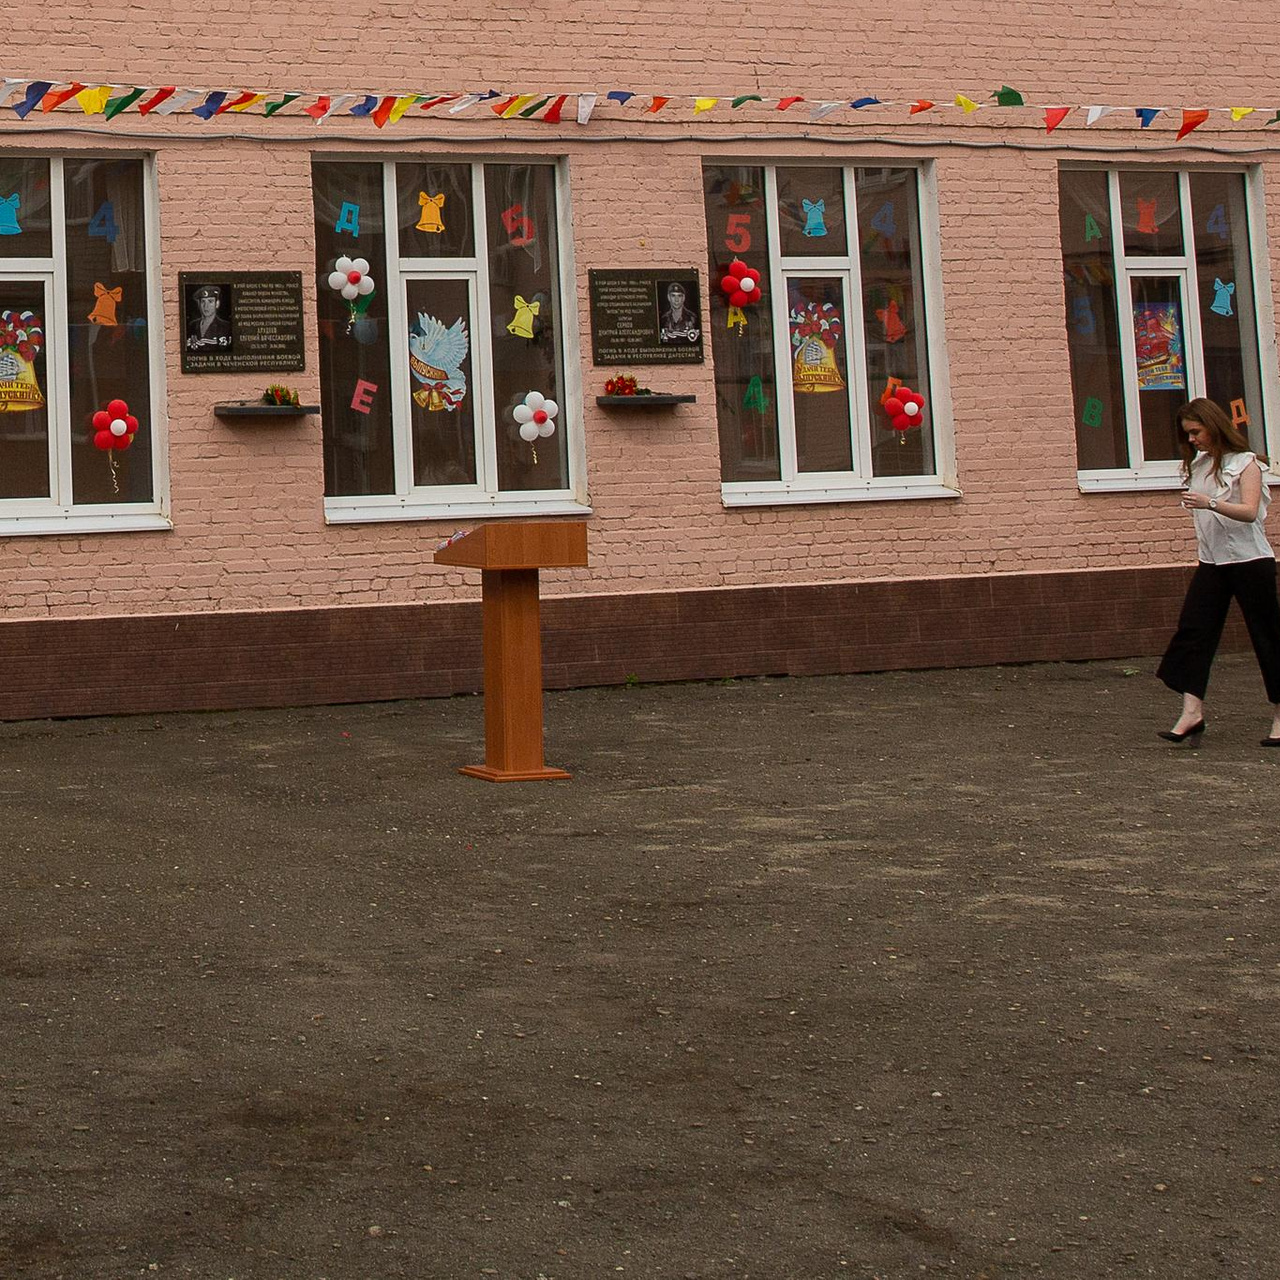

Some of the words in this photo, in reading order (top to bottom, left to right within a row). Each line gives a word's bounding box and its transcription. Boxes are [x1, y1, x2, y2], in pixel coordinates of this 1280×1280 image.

[87, 200, 120, 243] 4
[334, 201, 361, 238] Д
[500, 204, 537, 247] 5
[725, 214, 752, 254] 5
[871, 201, 896, 239] 4
[1084, 213, 1102, 243] А
[1206, 204, 1229, 239] 4
[1072, 295, 1096, 336] 5
[350, 379, 379, 415] Е
[743, 374, 770, 415] 4
[1082, 397, 1104, 428] В
[1230, 398, 1250, 429] Д
